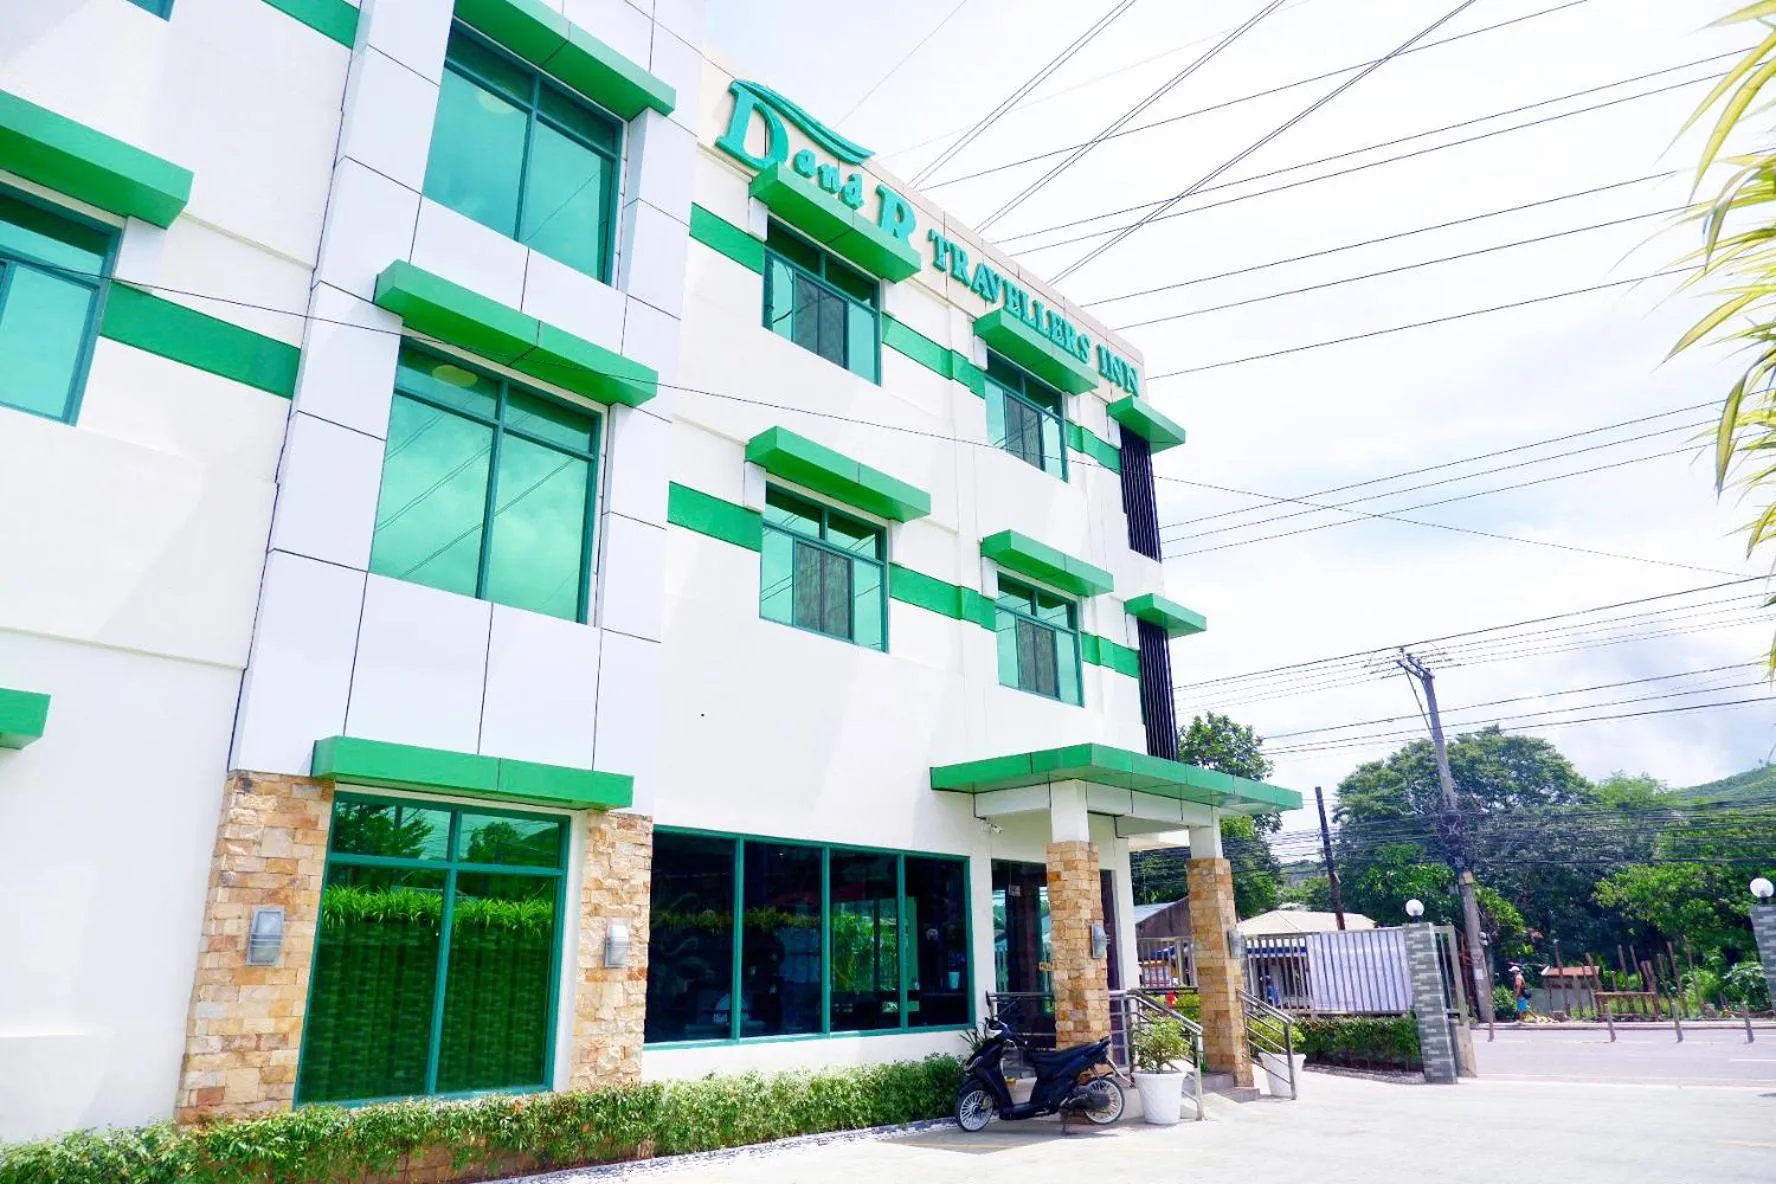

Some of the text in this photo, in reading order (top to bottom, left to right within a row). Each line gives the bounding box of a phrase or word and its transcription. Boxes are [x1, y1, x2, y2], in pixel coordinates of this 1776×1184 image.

[715, 79, 1140, 397] D and R TRAVELLERS INN
